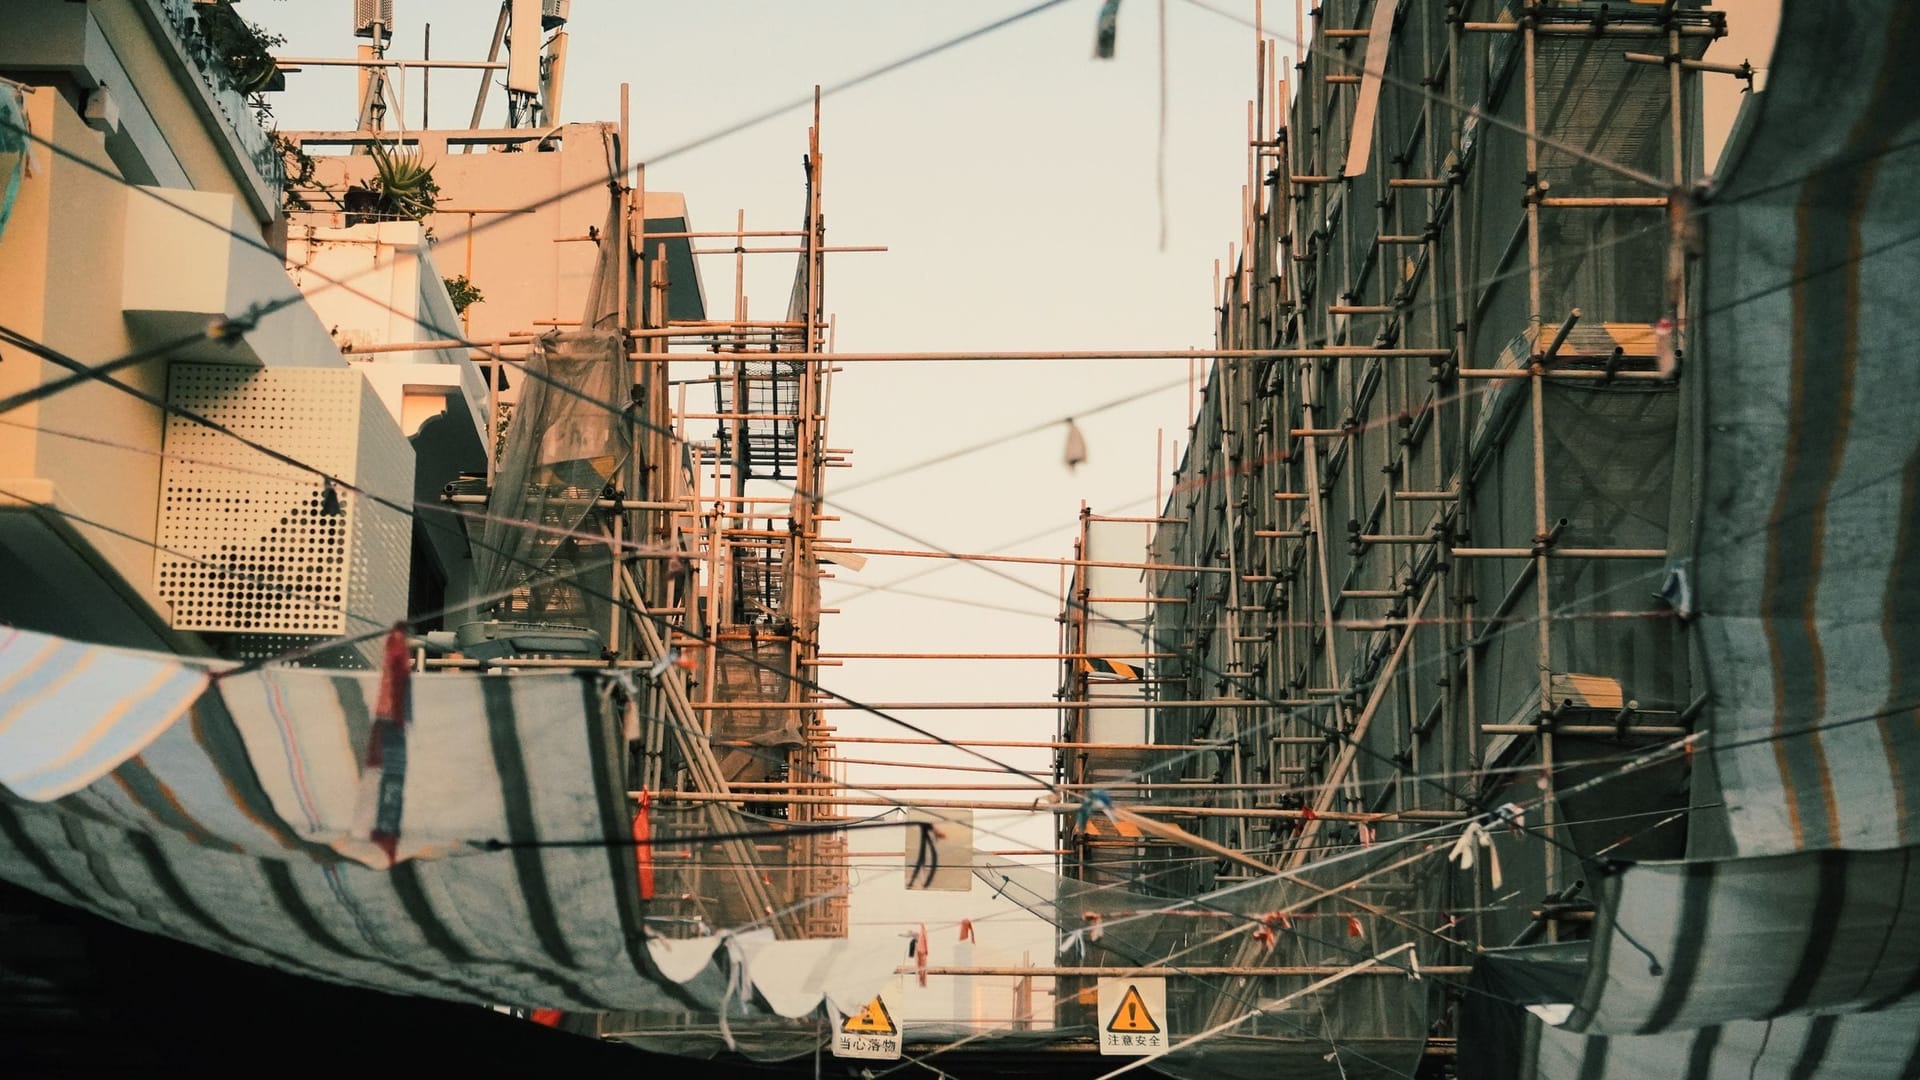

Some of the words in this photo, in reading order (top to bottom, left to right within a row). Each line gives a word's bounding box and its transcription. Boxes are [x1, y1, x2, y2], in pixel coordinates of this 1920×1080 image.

[840, 1037, 896, 1053] 当心落物
[1107, 1034, 1160, 1047] 注意安全
